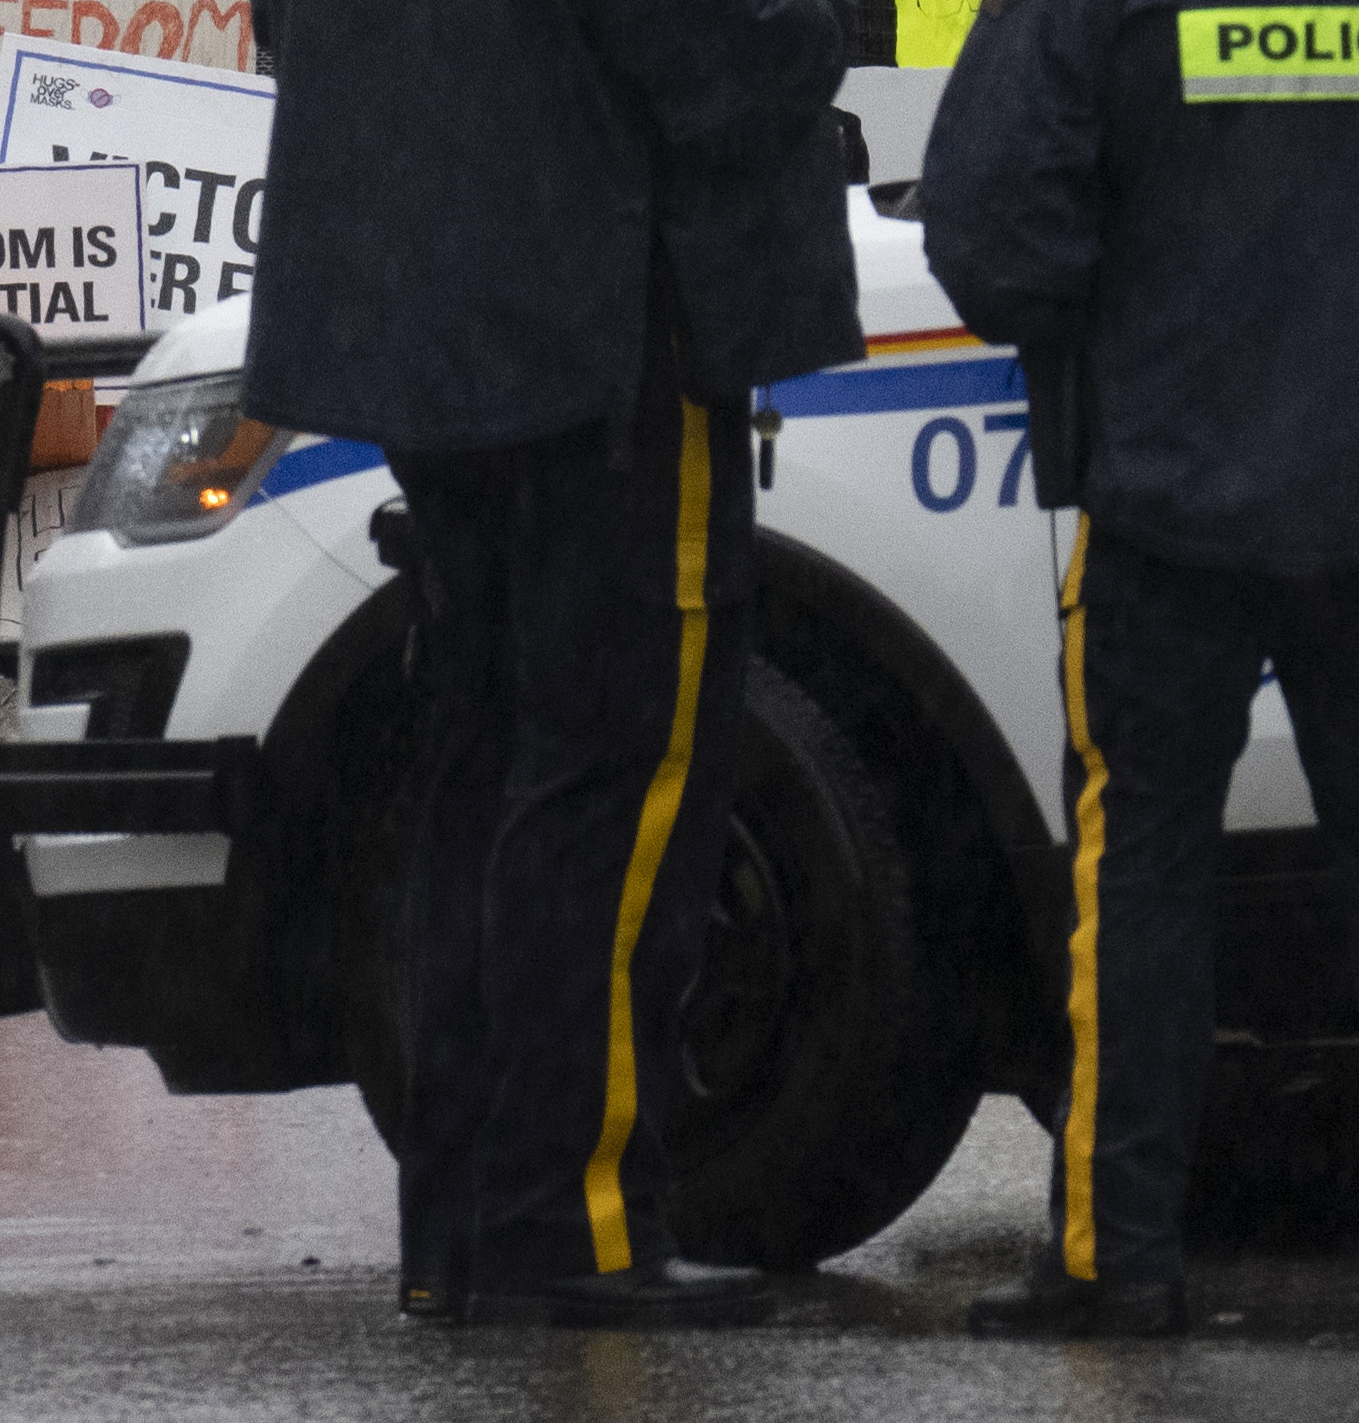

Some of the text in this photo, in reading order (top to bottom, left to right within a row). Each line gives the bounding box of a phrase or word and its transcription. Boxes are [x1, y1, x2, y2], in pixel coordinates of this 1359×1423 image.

[33, 73, 75, 91] HUGS
[30, 92, 73, 110] MASKS
[72, 224, 118, 269] IS
